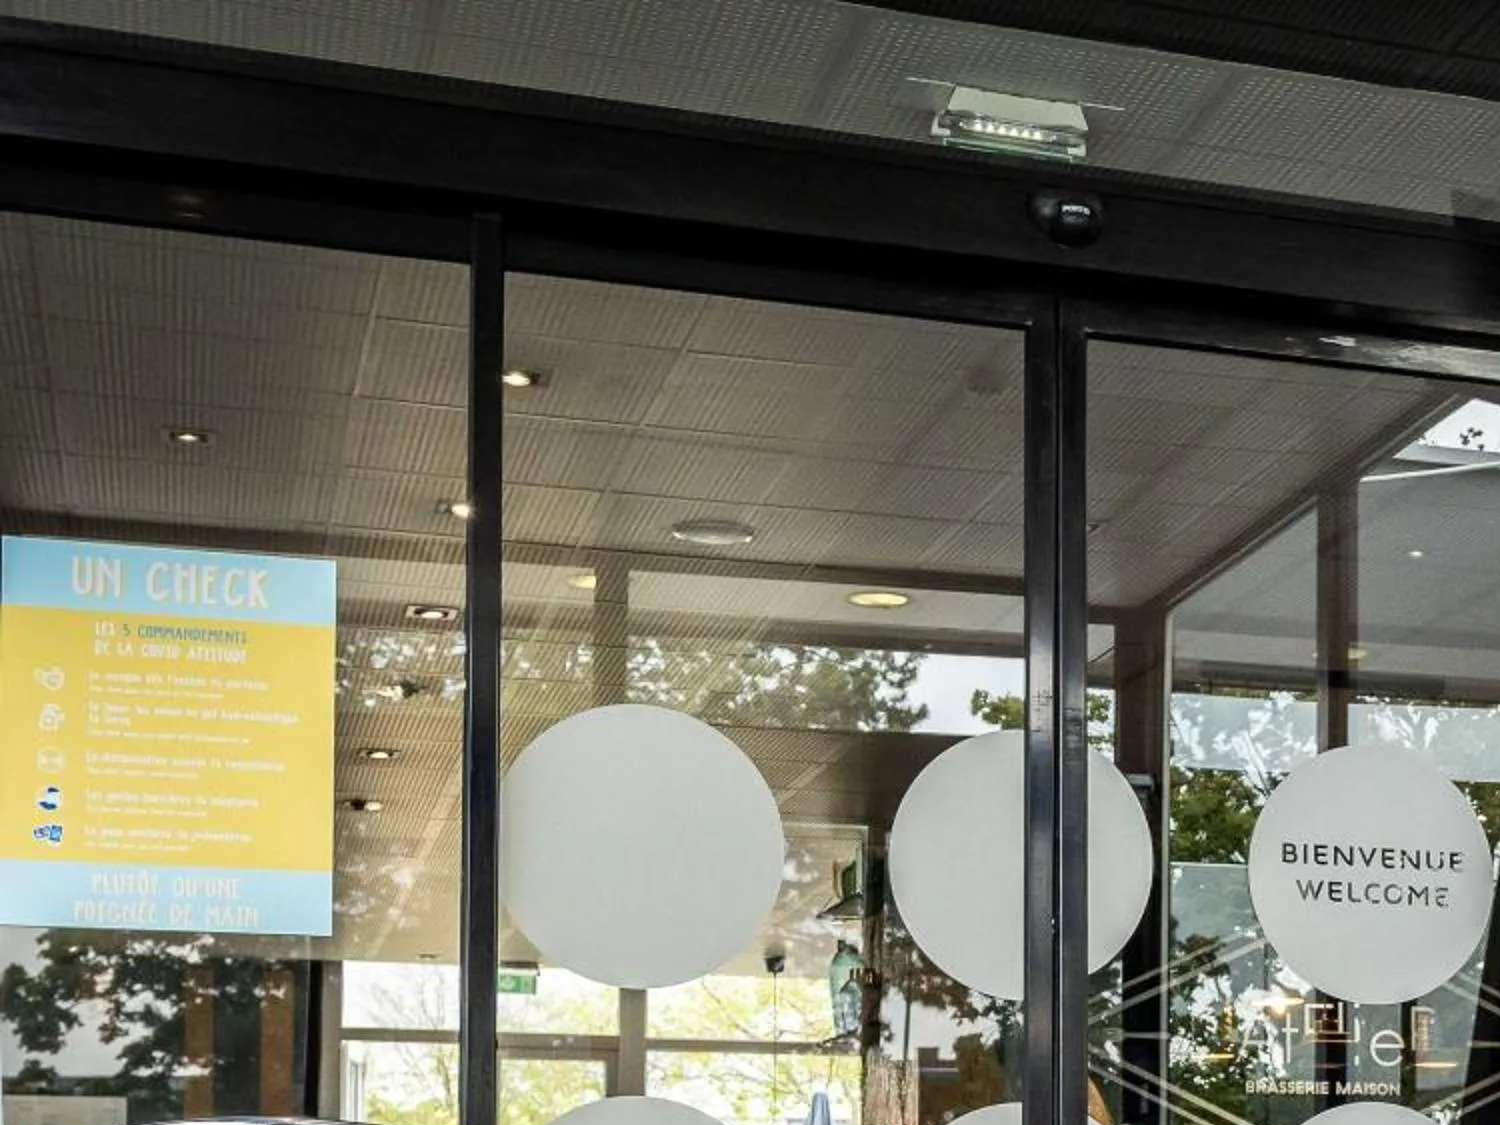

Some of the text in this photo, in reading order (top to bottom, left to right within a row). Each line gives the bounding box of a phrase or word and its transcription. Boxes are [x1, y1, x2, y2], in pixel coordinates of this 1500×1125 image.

[72, 556, 269, 609] UN CHECK
[123, 624, 131, 637] 5
[137, 624, 248, 645] COMMANDEMENTS
[117, 641, 133, 657] LA
[141, 643, 181, 660] COVID
[1281, 842, 1465, 874] BIENVENUE
[1296, 879, 1449, 908] WELCOME
[1245, 1080, 1400, 1098] BRASSERIE MAISON
